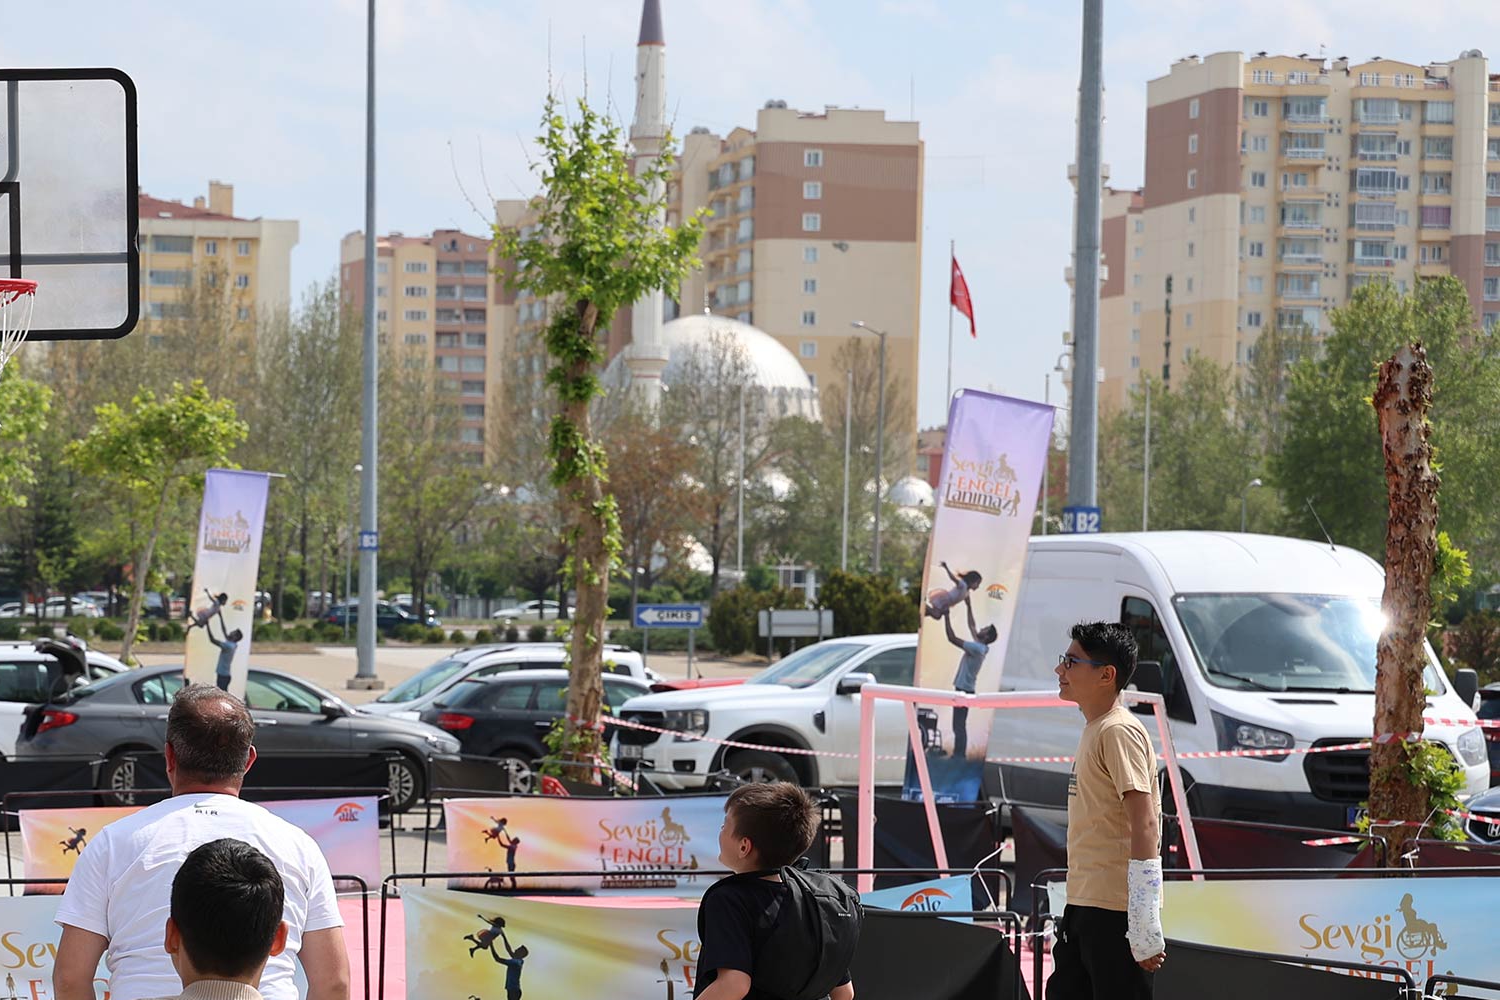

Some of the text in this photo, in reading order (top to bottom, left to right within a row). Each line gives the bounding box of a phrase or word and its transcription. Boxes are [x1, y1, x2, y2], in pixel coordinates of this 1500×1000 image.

[951, 454, 995, 478] Sevgi
[957, 476, 1012, 498] ENGEL
[1076, 512, 1099, 532] B2
[599, 818, 656, 846] Sevgi
[612, 846, 688, 865] ENGEL
[1299, 914, 1391, 960] Sevgi
